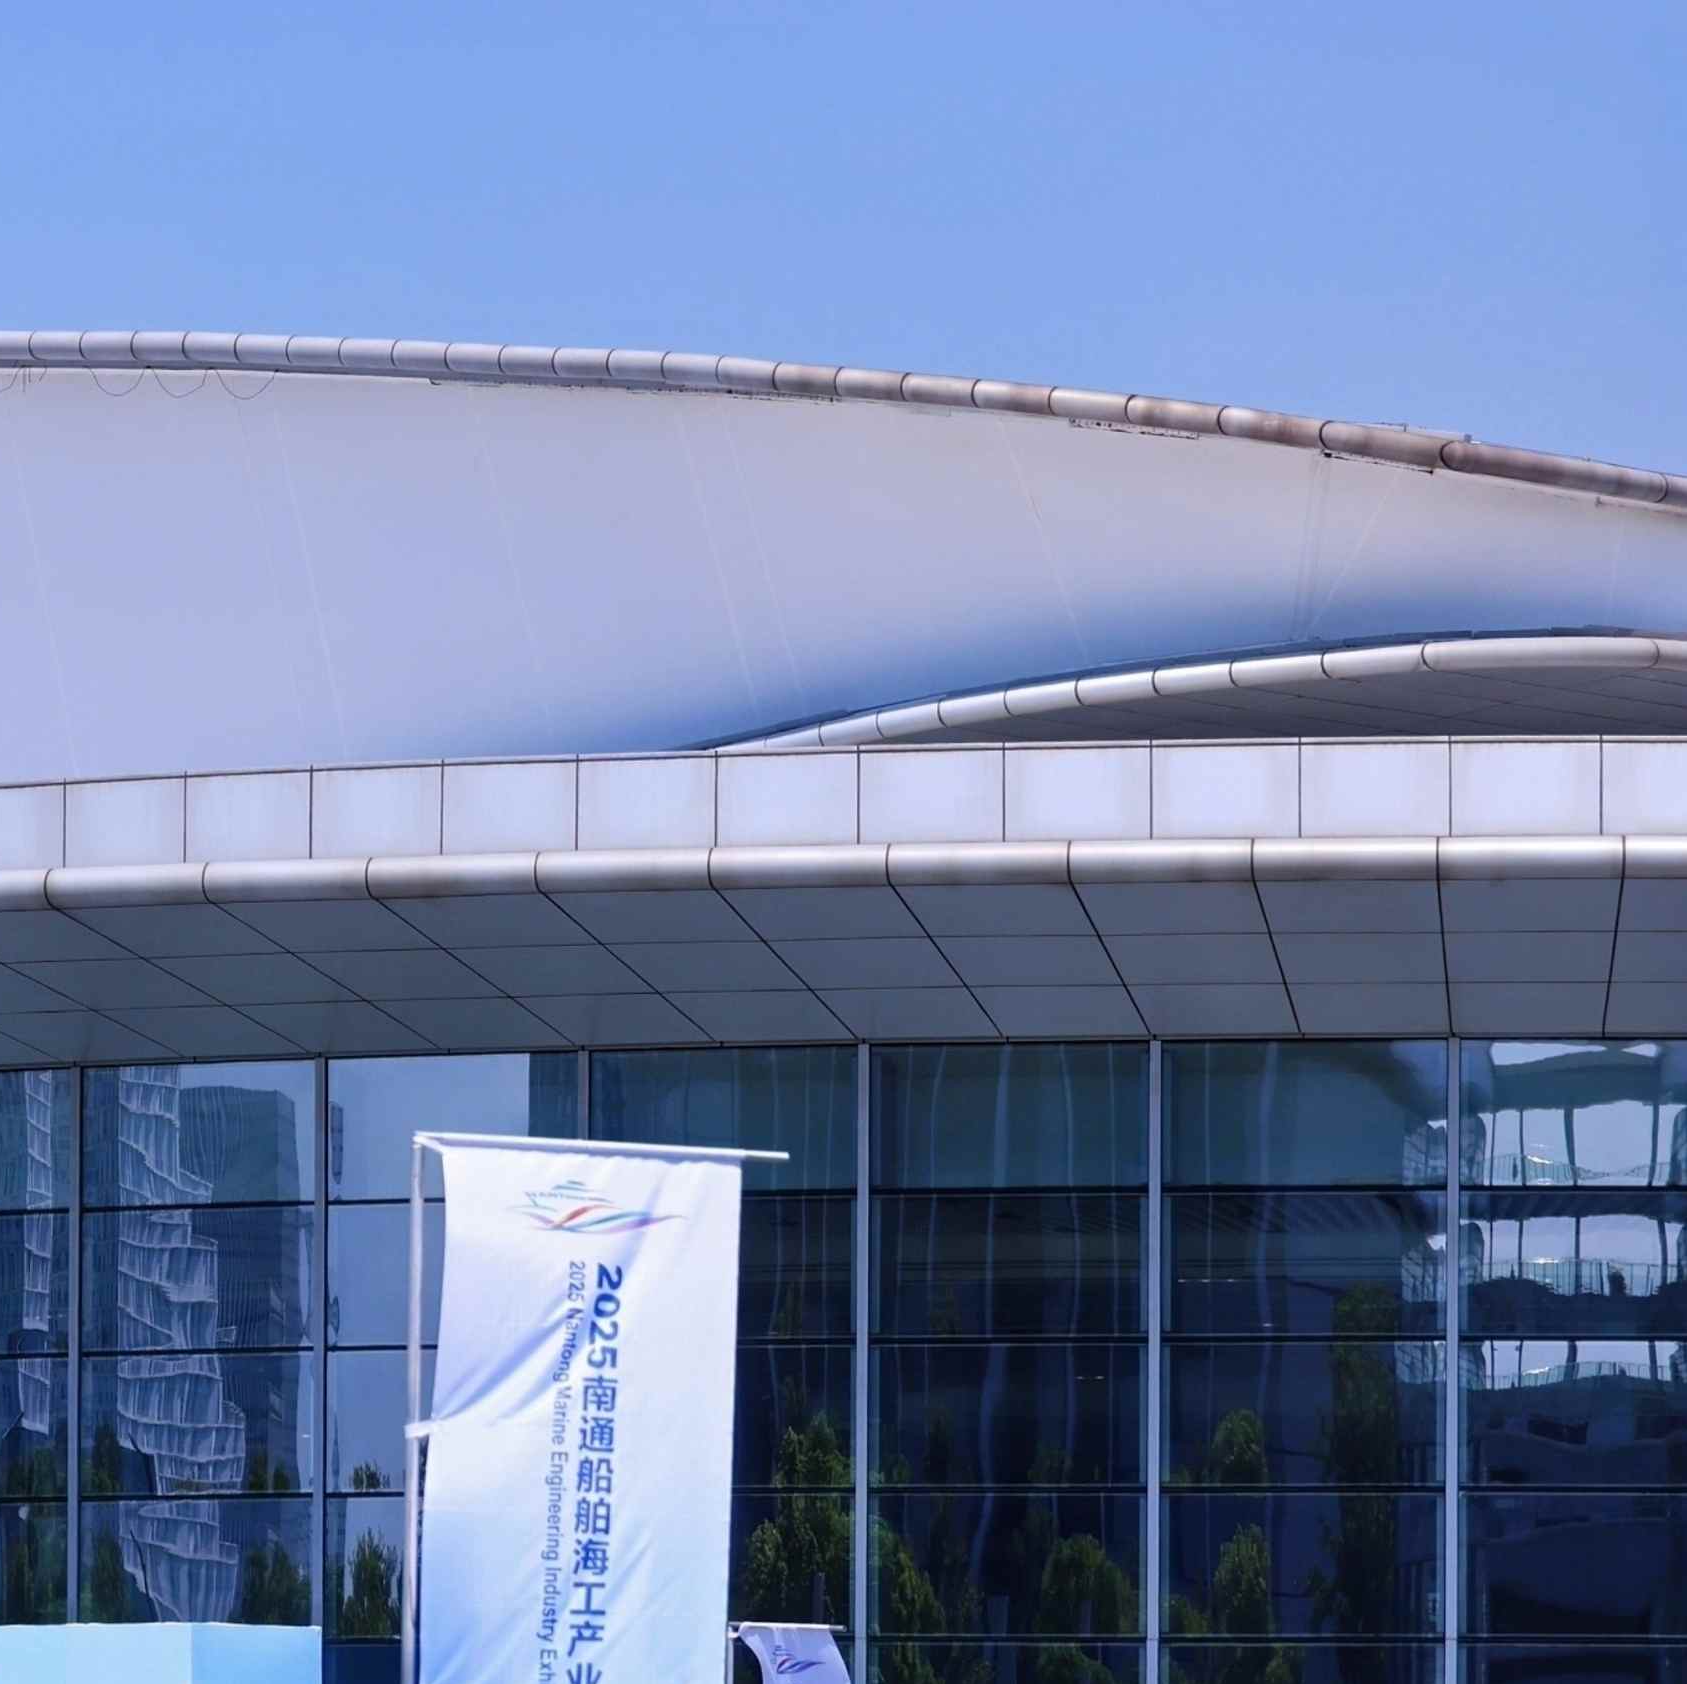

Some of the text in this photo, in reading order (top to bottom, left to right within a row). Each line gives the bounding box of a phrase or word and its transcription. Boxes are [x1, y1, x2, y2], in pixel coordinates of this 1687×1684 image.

[567, 1260, 586, 1302] 2025
[553, 1307, 584, 1382] Nantong
[551, 1386, 573, 1445] Marine
[541, 1451, 569, 1561] Engineering
[536, 1567, 563, 1644] Industry
